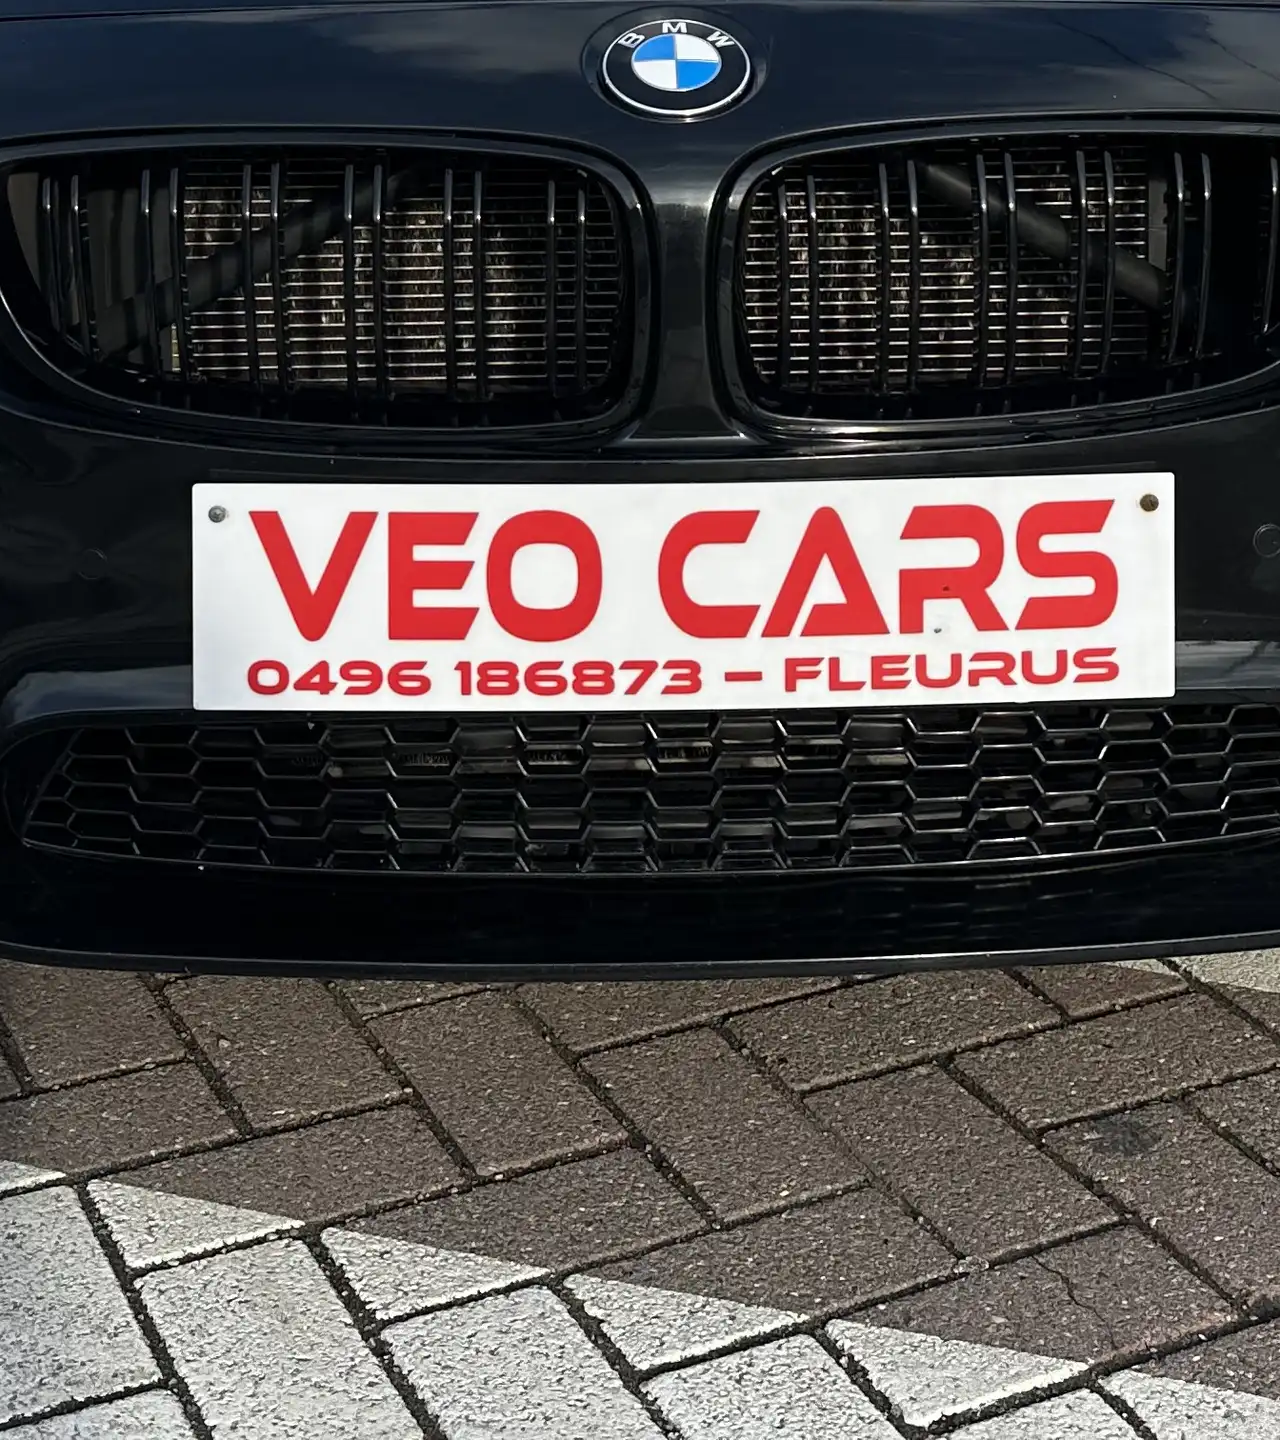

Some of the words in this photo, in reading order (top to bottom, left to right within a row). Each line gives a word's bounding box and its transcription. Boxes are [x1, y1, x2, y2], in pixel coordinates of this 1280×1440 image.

[617, 21, 736, 50] BMW
[248, 508, 603, 643] VEO
[657, 498, 1119, 639] CARS
[247, 658, 430, 696] 0496
[453, 659, 703, 696] 186873
[783, 646, 1120, 693] FLEURUS
